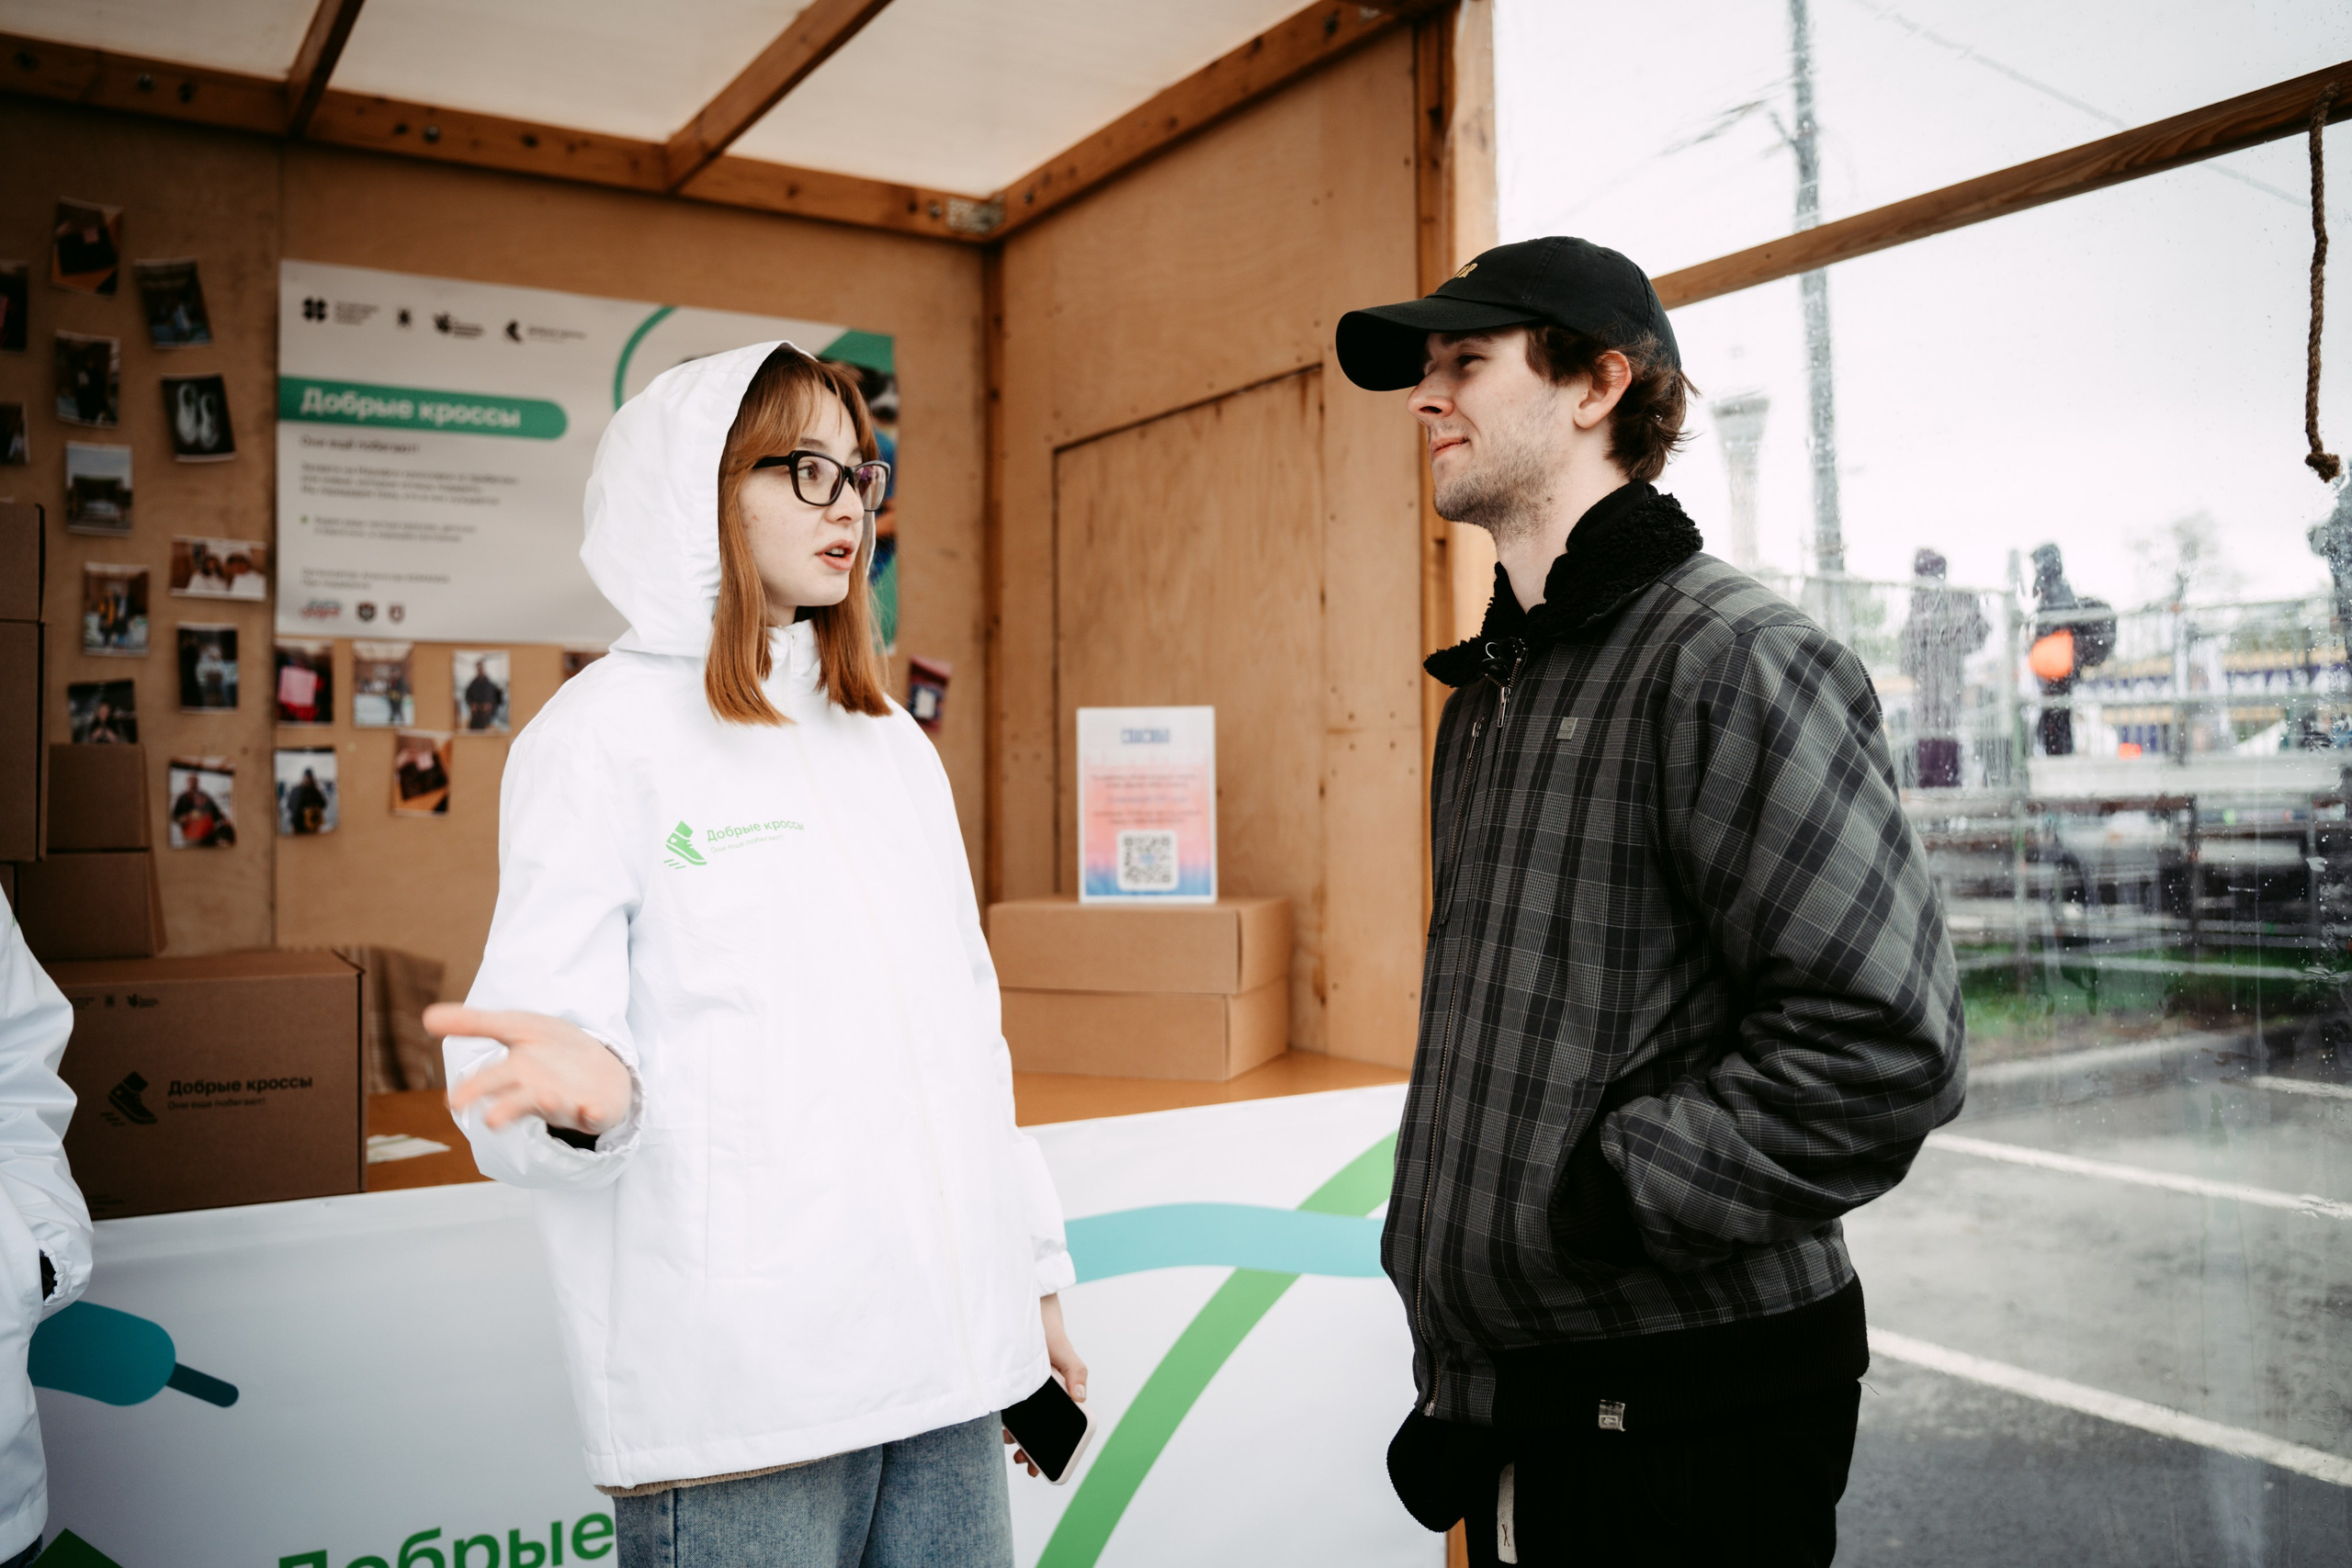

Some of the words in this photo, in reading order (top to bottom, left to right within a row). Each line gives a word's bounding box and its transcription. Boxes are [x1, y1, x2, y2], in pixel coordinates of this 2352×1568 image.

[300, 386, 414, 421] Добрые
[418, 401, 521, 428] кроссы
[707, 823, 762, 842] Добрые
[763, 819, 805, 831] кроссы
[710, 845, 727, 853] Они
[167, 1078, 242, 1097] Добрые
[246, 1076, 313, 1094] кроссы
[278, 1512, 616, 1568] брые
